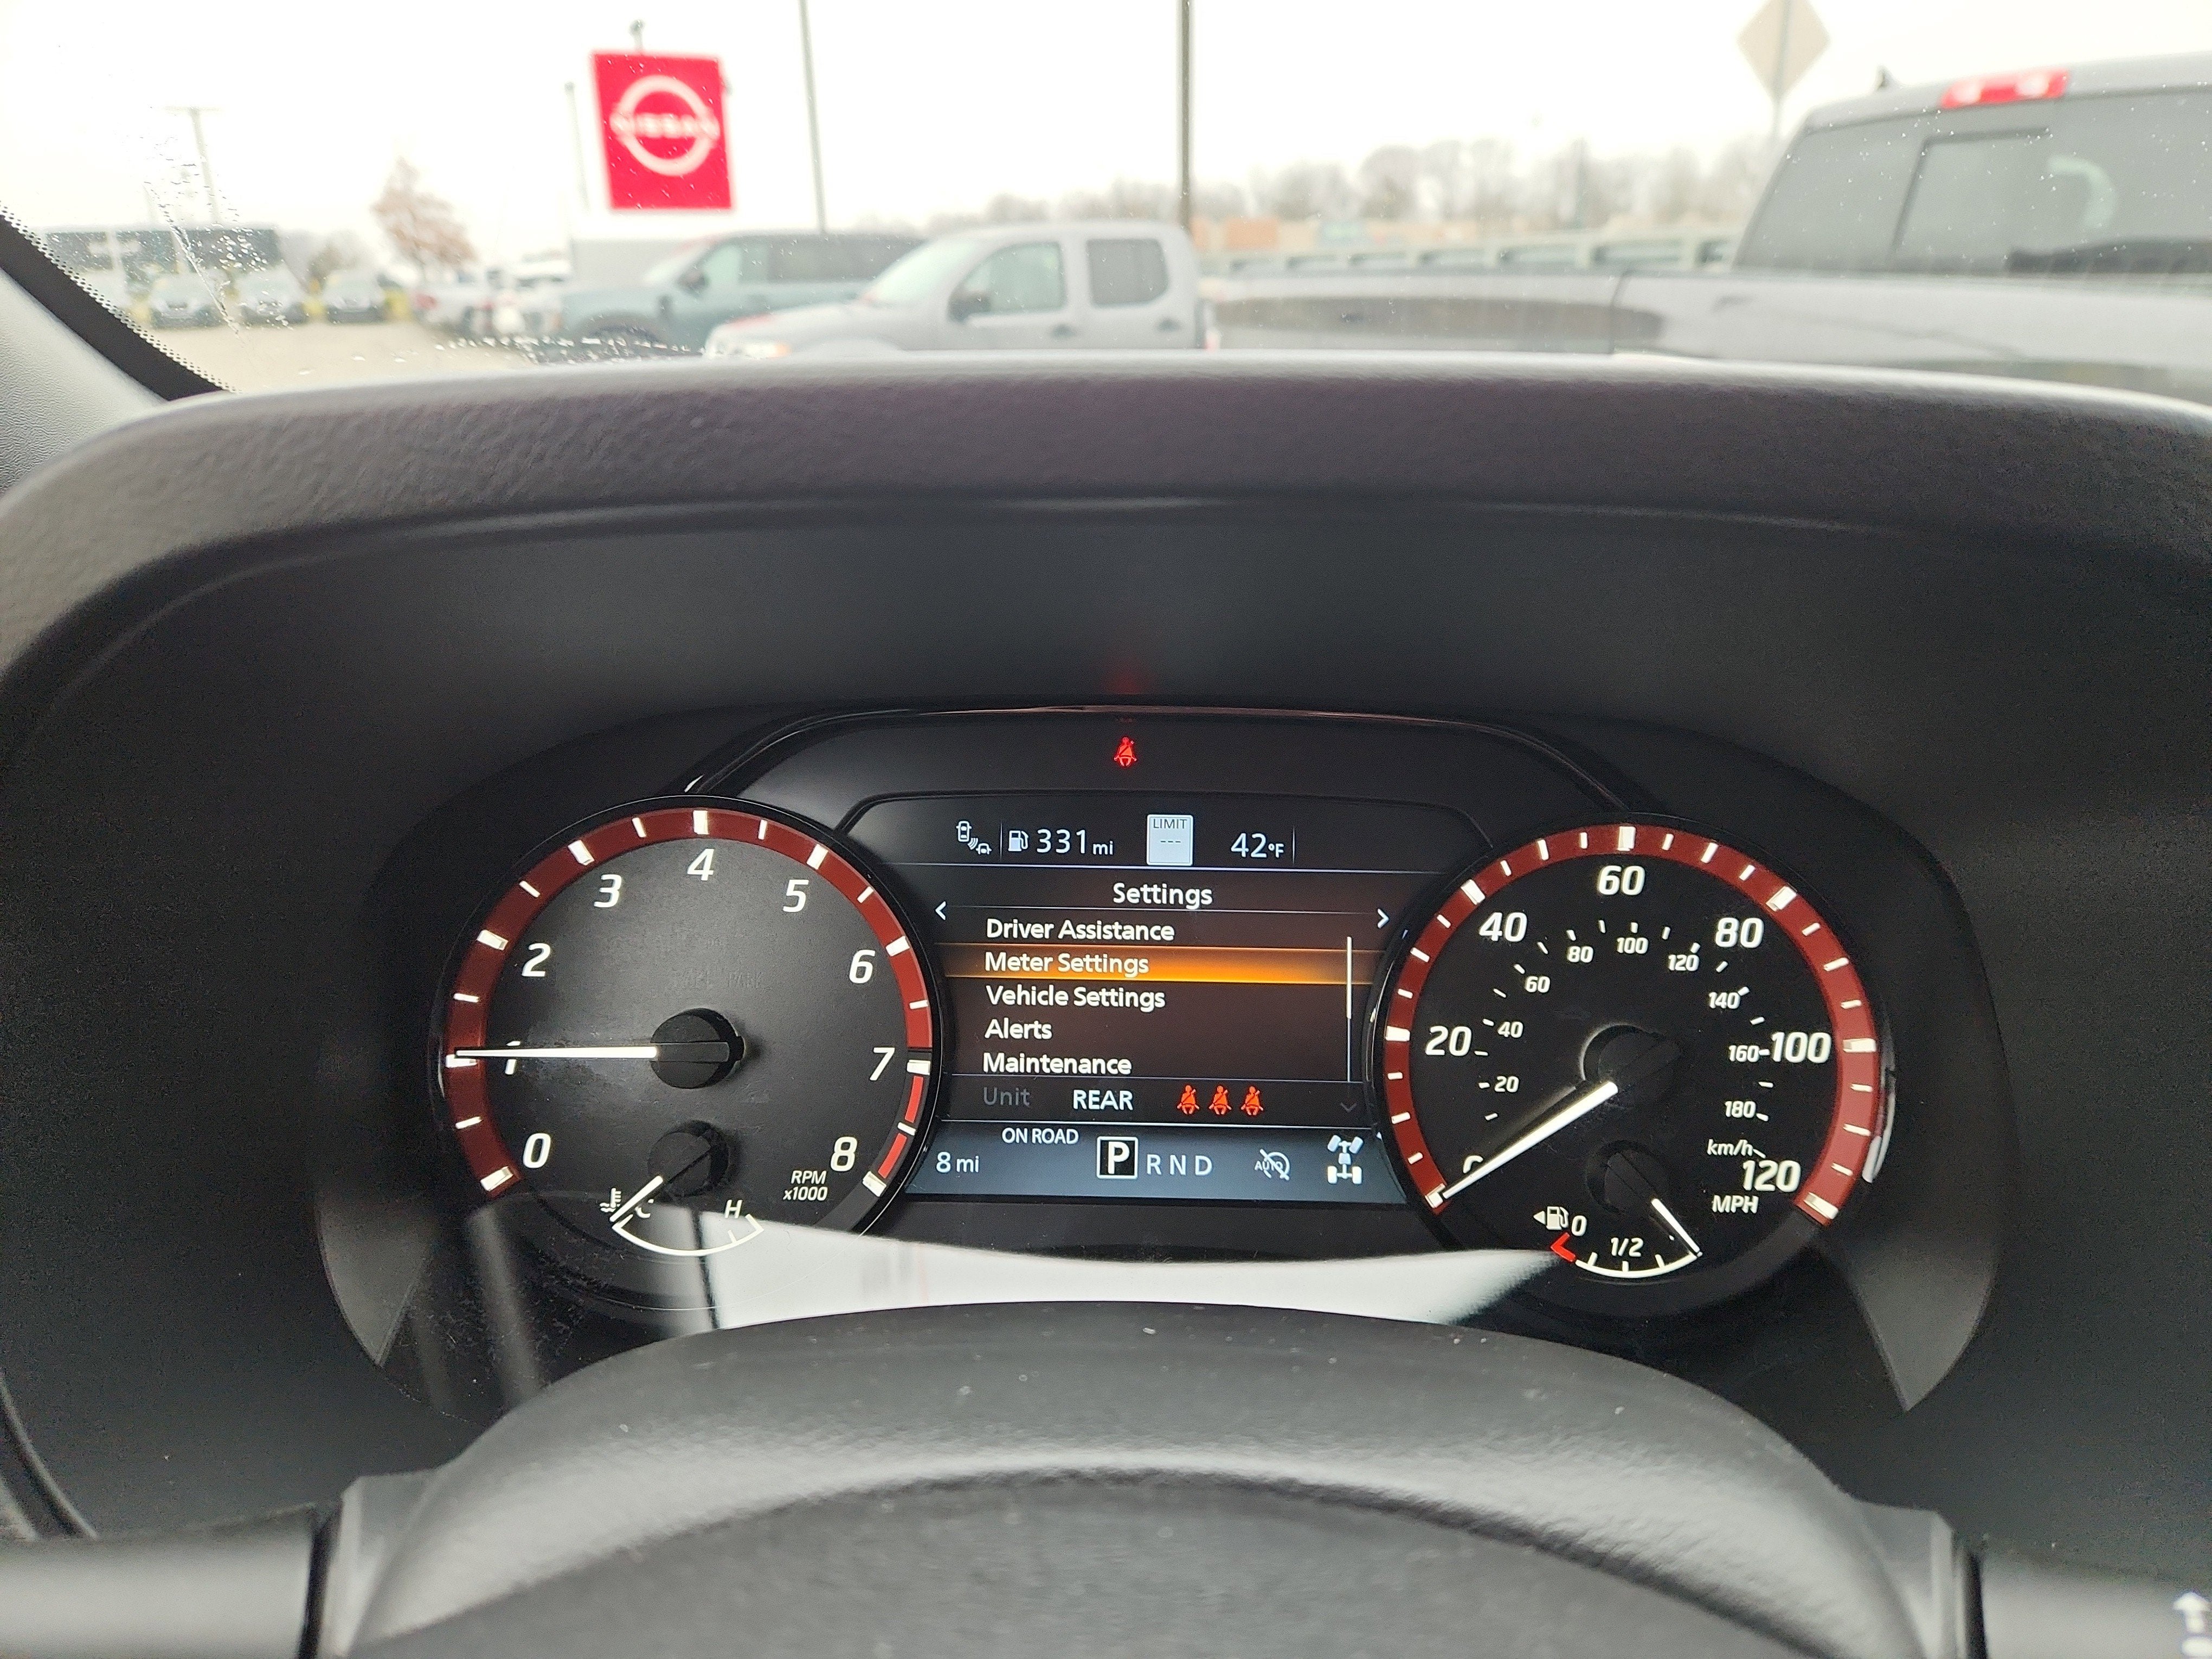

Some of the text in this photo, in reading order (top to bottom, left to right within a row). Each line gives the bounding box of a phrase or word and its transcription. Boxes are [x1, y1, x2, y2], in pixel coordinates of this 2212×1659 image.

[1153, 819, 1186, 829] LIMIT
[1037, 828, 1113, 855] 331 mi
[687, 848, 715, 881] 4
[594, 874, 622, 908] 3
[1598, 865, 1644, 895] 60
[782, 879, 809, 912] 5
[1113, 882, 1213, 909] Settings
[987, 918, 1175, 941] Driver Assistance
[1479, 912, 1527, 942] 40
[1715, 917, 1763, 948] 80
[1567, 946, 1593, 963] 80
[1617, 937, 1648, 954] 100
[522, 943, 551, 977] 2
[849, 949, 876, 983] 6
[985, 951, 1149, 978] Meter Settings
[1668, 954, 1699, 972] 120
[1525, 976, 1551, 993] 60
[986, 984, 1166, 1013] Vehicle Settings
[1708, 992, 1739, 1009] 140
[984, 1017, 1052, 1039] Alerts
[1497, 1021, 1523, 1038] 40
[1425, 1026, 1471, 1056] 20
[1772, 1032, 1831, 1063] 100
[870, 1047, 895, 1081] 7
[983, 1052, 1133, 1075] Maintenance
[1728, 1045, 1758, 1063] 160
[1494, 1076, 1519, 1092] 20
[983, 1086, 1031, 1108] Unit
[1073, 1089, 1133, 1110] REAR
[1725, 1101, 1755, 1118] 180
[1002, 1127, 1079, 1144] ON ROAD
[523, 1133, 551, 1168] 0
[831, 1136, 858, 1172] 8
[1108, 1141, 1212, 1176] P R N D
[1707, 1139, 1752, 1156] km/h
[936, 1152, 979, 1173] 8 mi
[791, 1170, 827, 1185] RPM
[1743, 1160, 1801, 1192] 120
[783, 1186, 828, 1201] x1000
[1712, 1195, 1759, 1213] MPH
[724, 1199, 743, 1219] H
[1571, 1215, 1587, 1236] 0
[1611, 1237, 1643, 1257] 1/2
